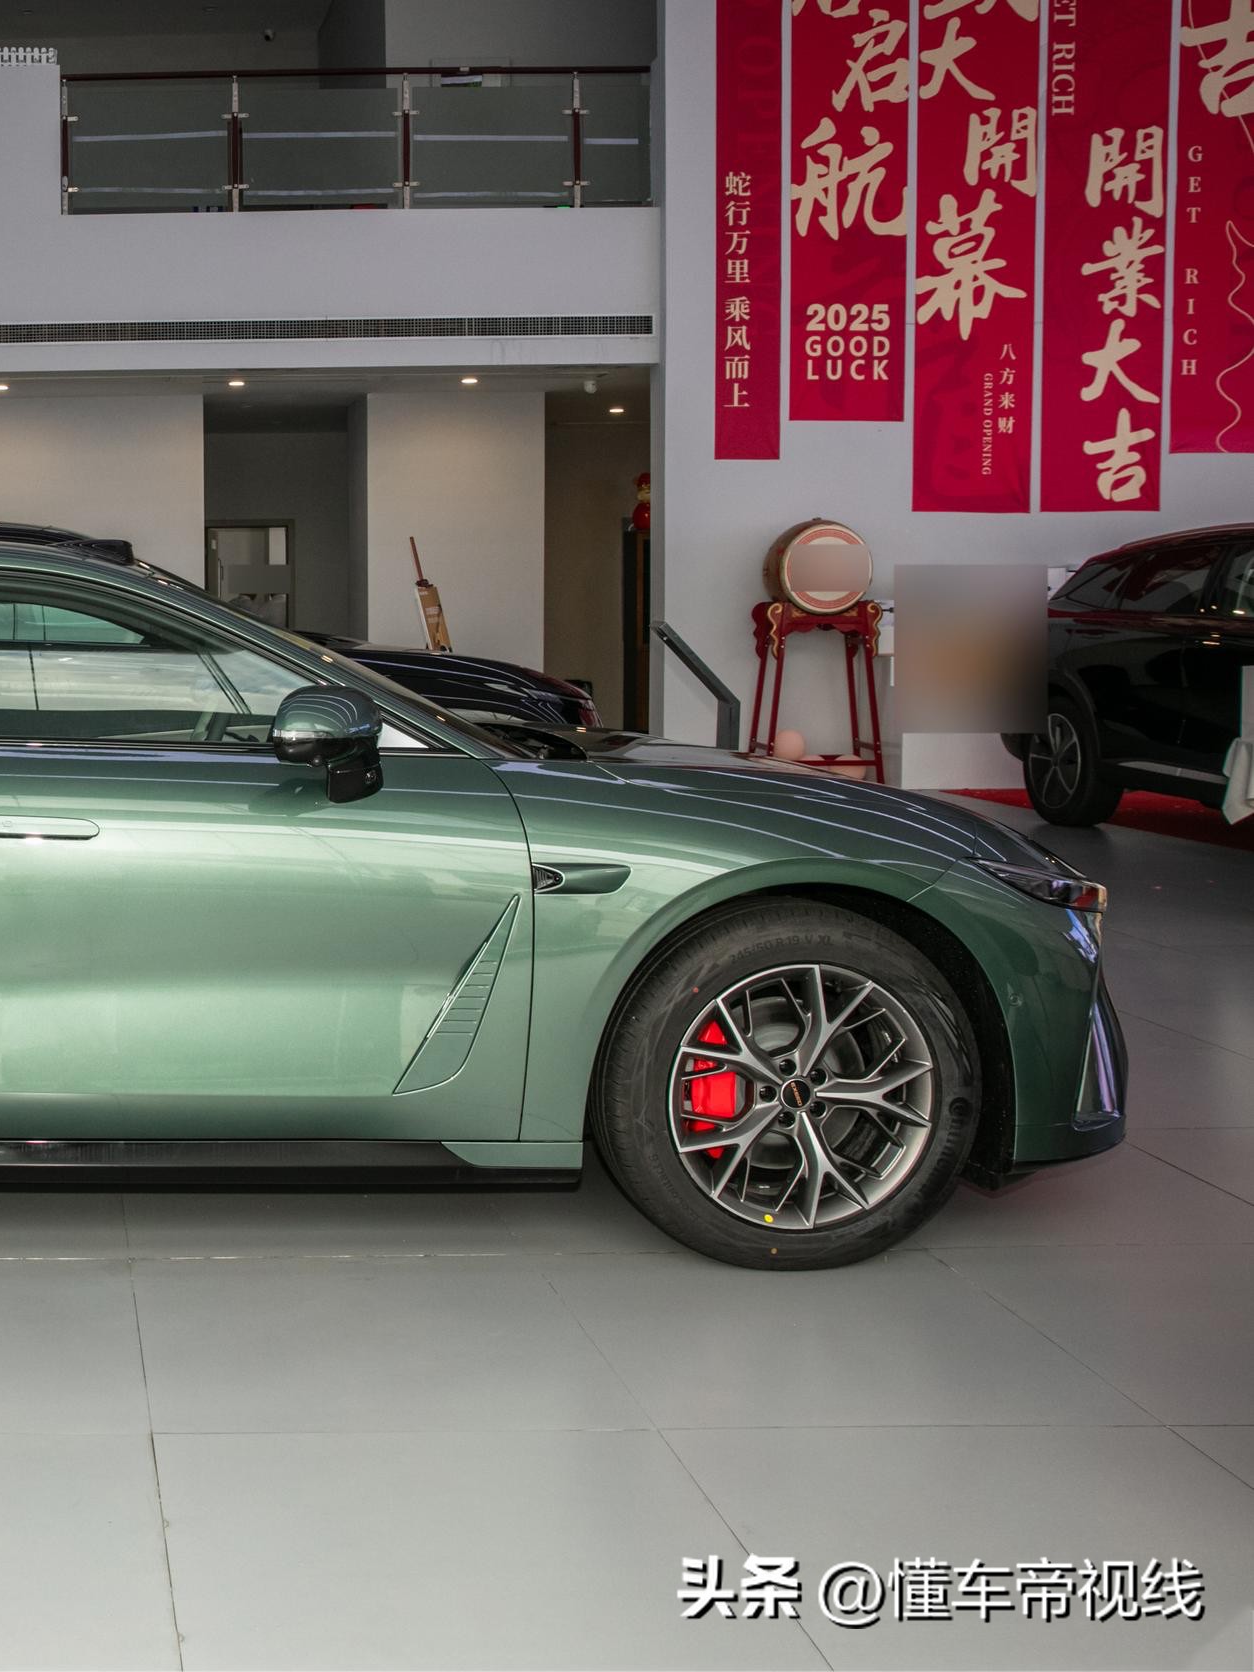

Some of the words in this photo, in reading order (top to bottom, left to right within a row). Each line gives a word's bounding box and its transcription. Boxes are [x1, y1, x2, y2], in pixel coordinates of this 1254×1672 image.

[792, 0, 909, 241] 启航
[1052, 42, 1076, 116] RICH
[916, 0, 1038, 341] 大開幕
[1187, 146, 1203, 223] GET
[725, 171, 751, 284] 蛇行万里
[723, 296, 751, 408] 乘风而上
[805, 335, 890, 357] GOOD
[806, 303, 890, 331] 2025
[1080, 125, 1165, 502] 開業大吉
[1180, 268, 1199, 375] RICH
[807, 359, 889, 380] LUCK
[983, 372, 994, 416] GRAND
[997, 343, 1016, 434] 八方来财
[981, 419, 993, 475] OPENING
